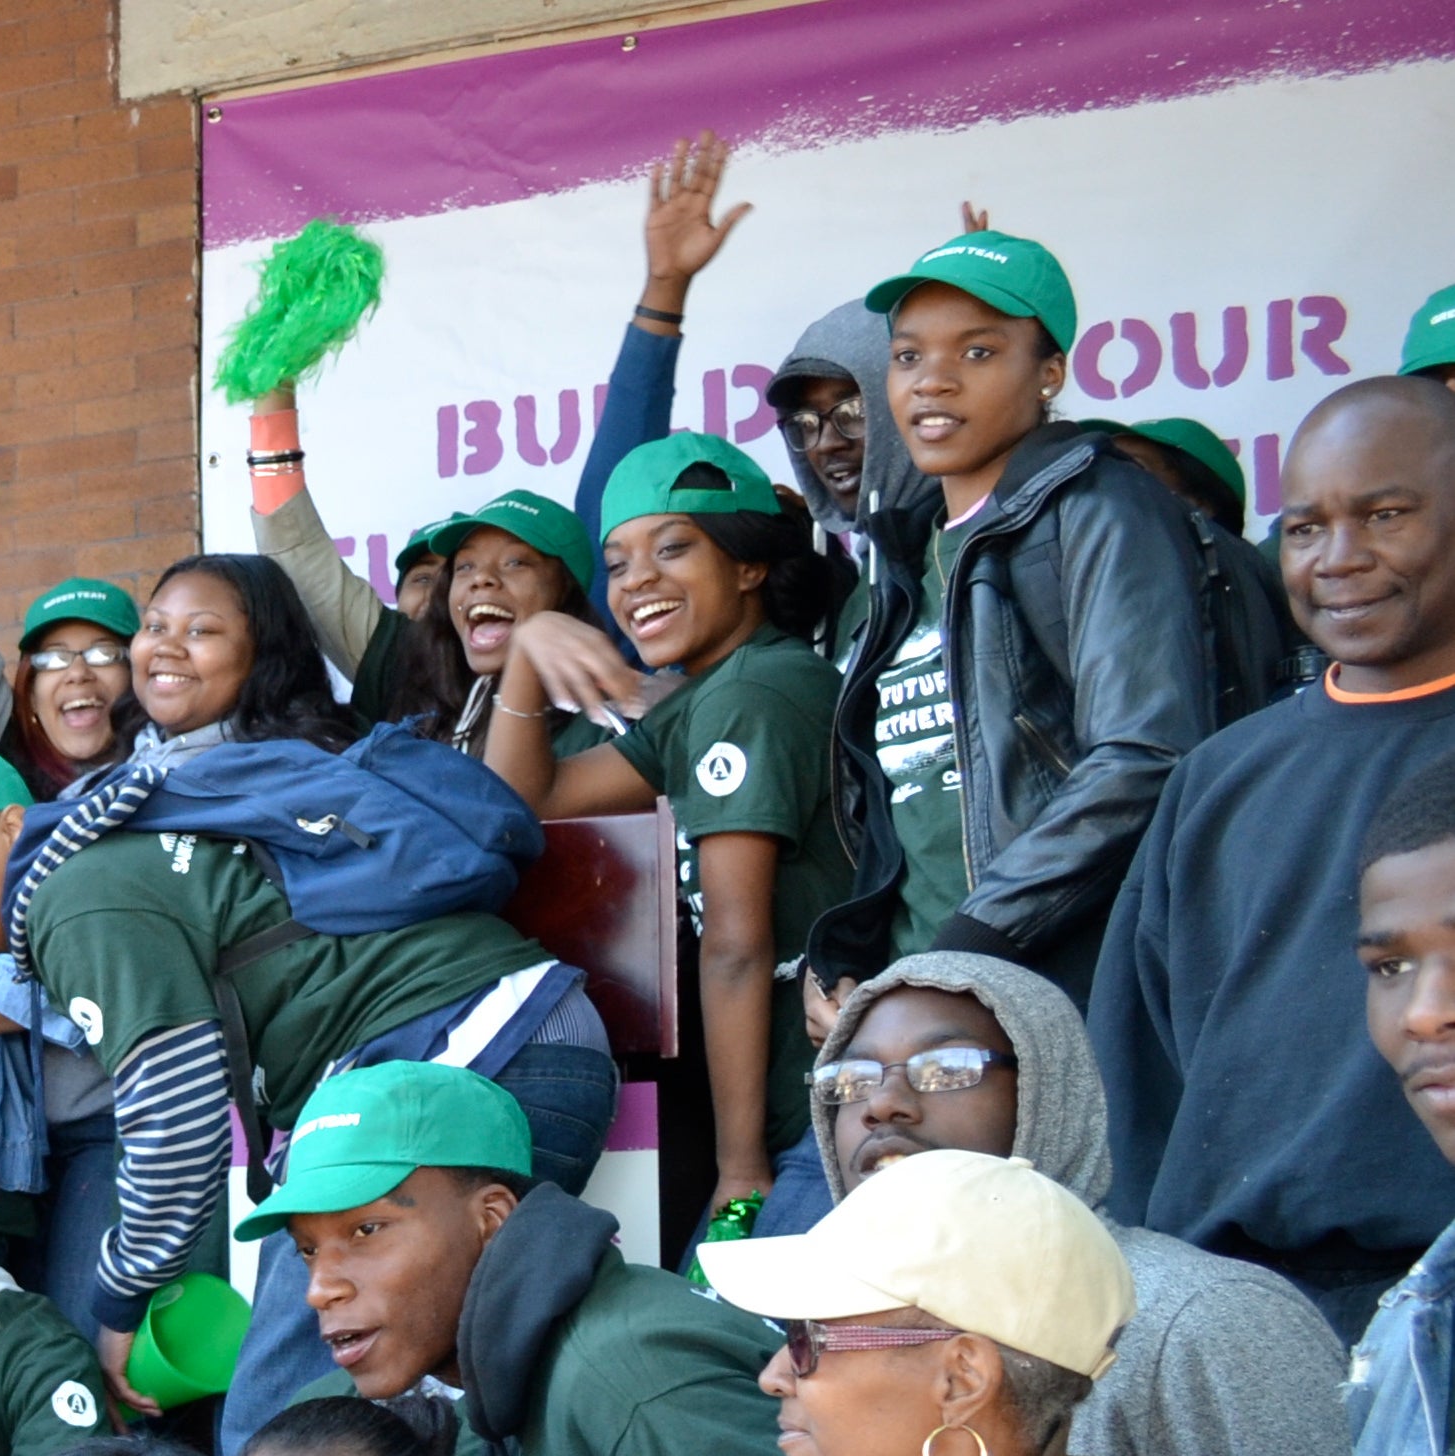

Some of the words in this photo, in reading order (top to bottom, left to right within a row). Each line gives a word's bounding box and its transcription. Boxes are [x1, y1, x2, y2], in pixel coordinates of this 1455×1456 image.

[967, 247, 1007, 264] TEAM
[437, 364, 779, 478] BUD
[1073, 296, 1351, 401] OUR
[507, 499, 539, 515] TEAM
[77, 590, 107, 601] TEAM
